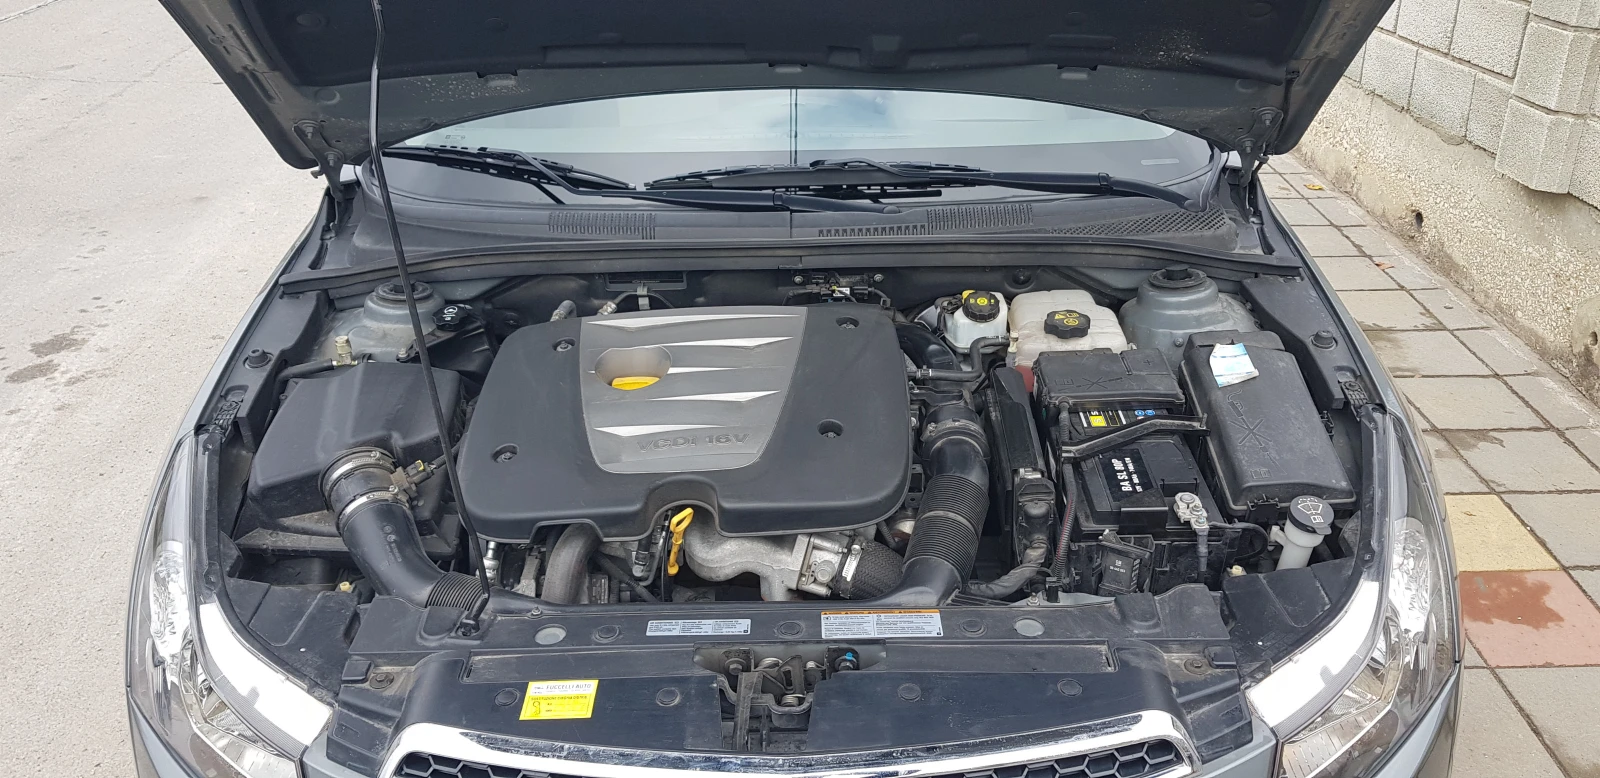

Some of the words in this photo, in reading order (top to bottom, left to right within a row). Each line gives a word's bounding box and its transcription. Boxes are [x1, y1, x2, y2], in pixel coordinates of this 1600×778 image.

[705, 433, 750, 447] 16V
[1116, 471, 1128, 480] SL
[1120, 481, 1132, 492] BA
